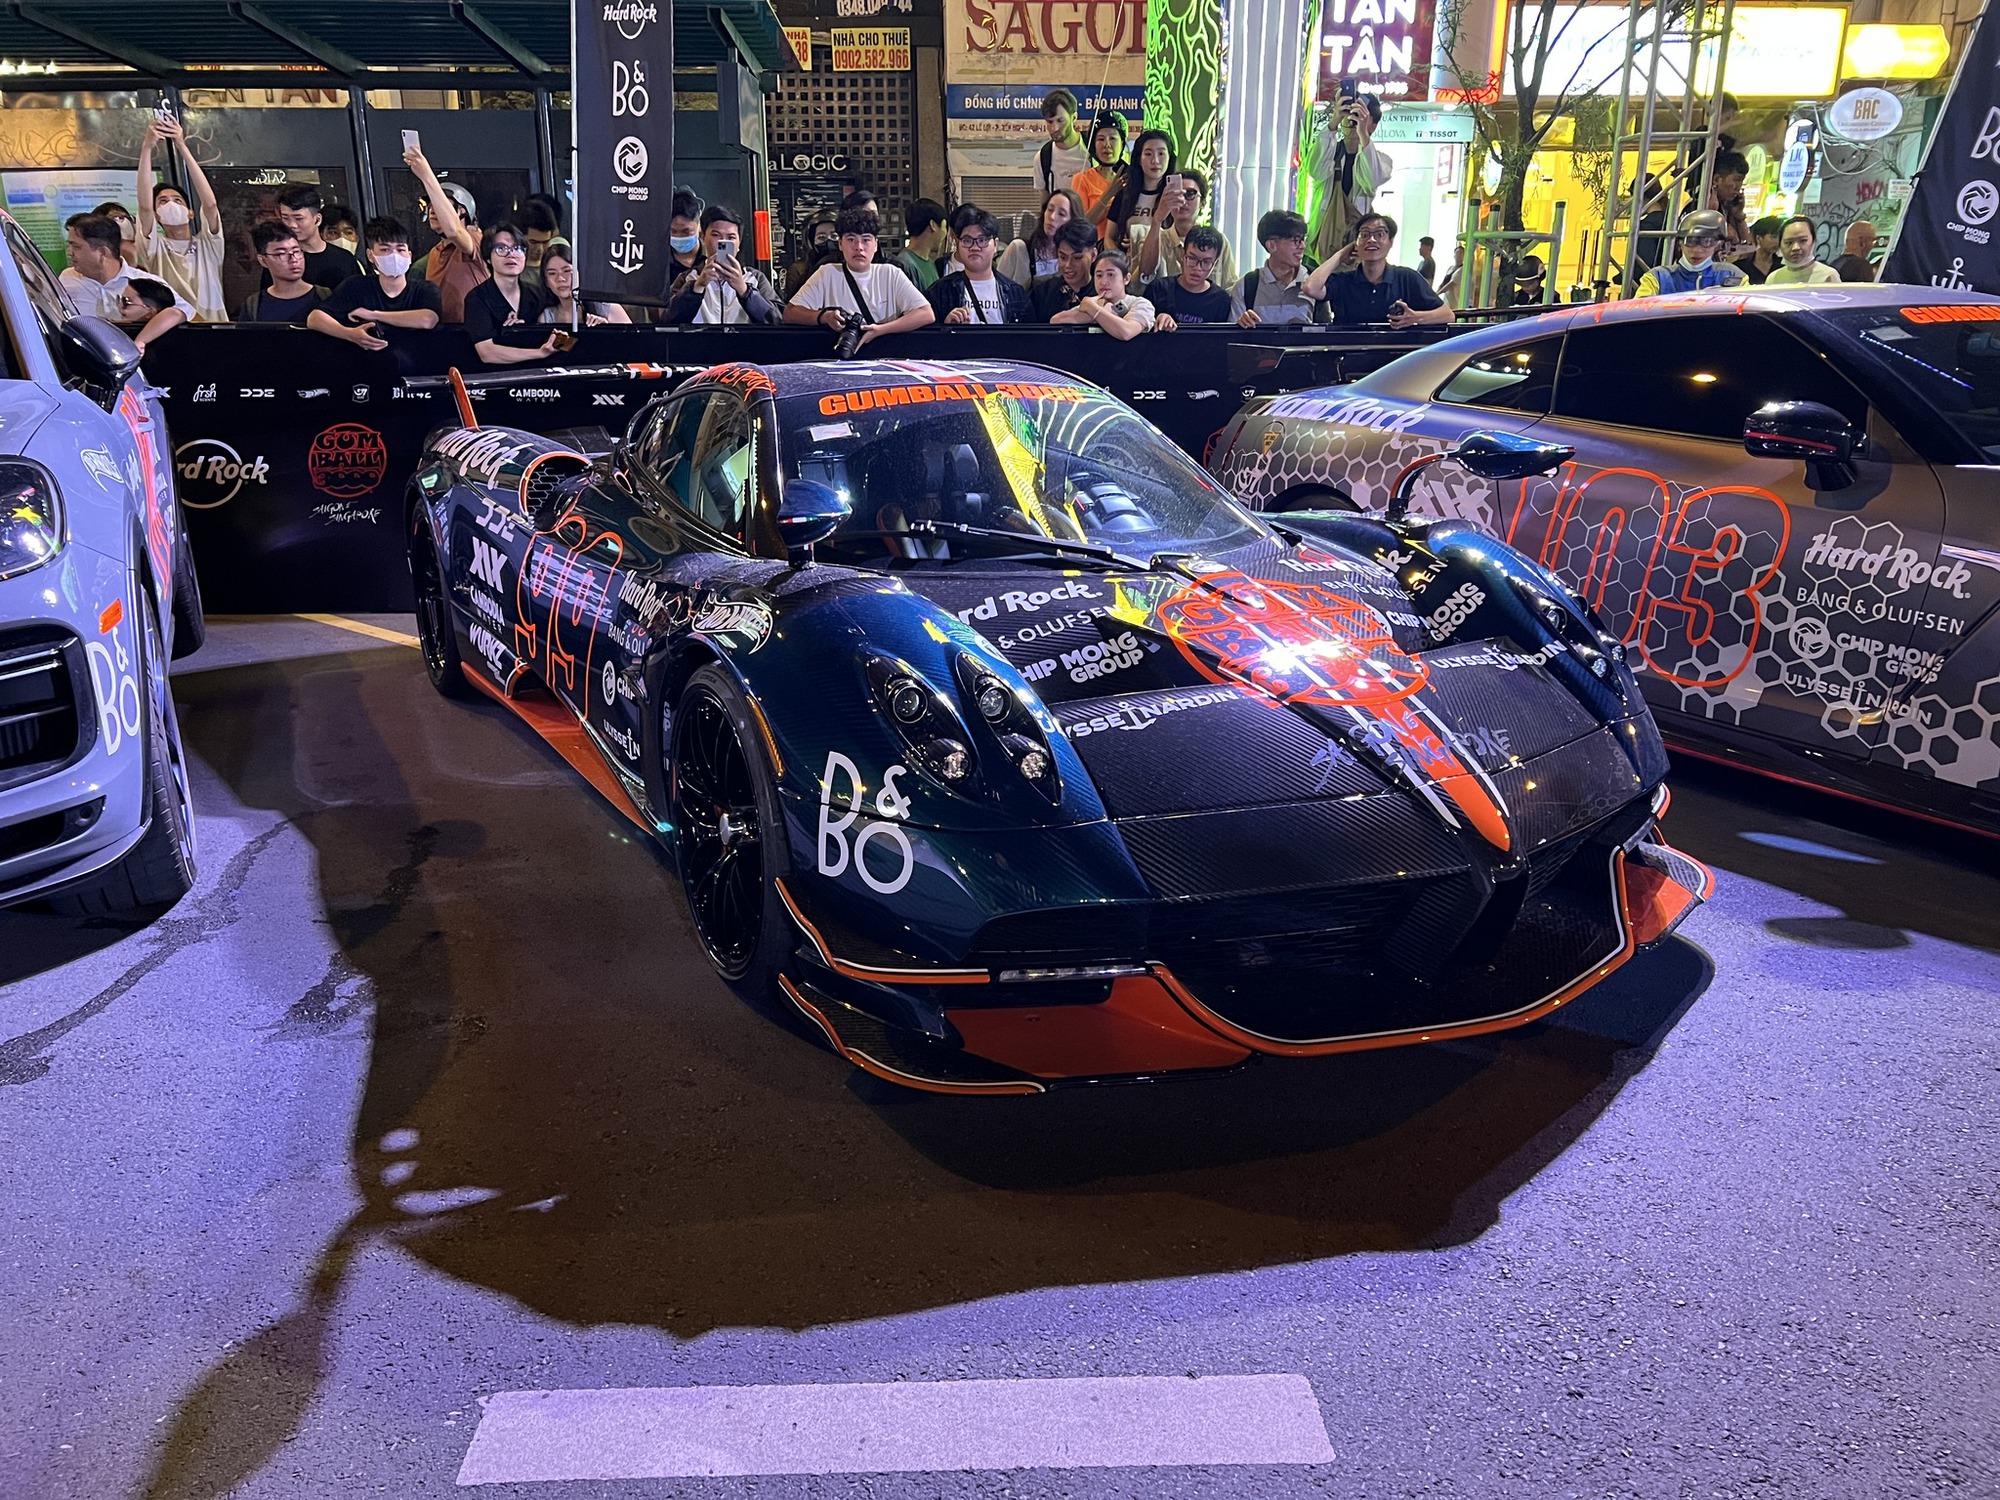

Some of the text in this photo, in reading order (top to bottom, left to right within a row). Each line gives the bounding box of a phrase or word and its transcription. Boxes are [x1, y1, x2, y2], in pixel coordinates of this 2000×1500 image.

[603, 3, 657, 23] Hard Rock
[834, 30, 908, 46] NHÀ CHO THUÊ
[1323, 25, 1412, 74] TÂN
[834, 49, 909, 69] 0902.582.966
[1110, 95, 1138, 110] HÀNH
[781, 153, 847, 171] LOGIC
[611, 186, 627, 194] CHIP
[1946, 222, 1990, 239] CHIP MONG
[1964, 233, 1989, 244] GROUP
[509, 389, 561, 398] CAMBODIA
[819, 383, 988, 416] GUMBALL
[177, 455, 270, 485] rd Rock
[1806, 533, 1893, 575] Hard
[618, 569, 652, 612] Hard
[957, 596, 998, 626] rd
[1386, 582, 1480, 630] CHIP MONG
[1429, 591, 1487, 643] GROUP
[1797, 587, 1965, 636] BANG & OLUFSEN
[997, 635, 1016, 649] &
[1017, 631, 1139, 682] HIP MONG
[1836, 632, 1946, 672] CHIP MONG
[1070, 649, 1144, 684] GROUP
[1885, 659, 1939, 685] GROUP
[1785, 672, 1851, 699] ULYSSE
[1141, 690, 1240, 719] NARDIN
[603, 718, 628, 749] ULYSSE
